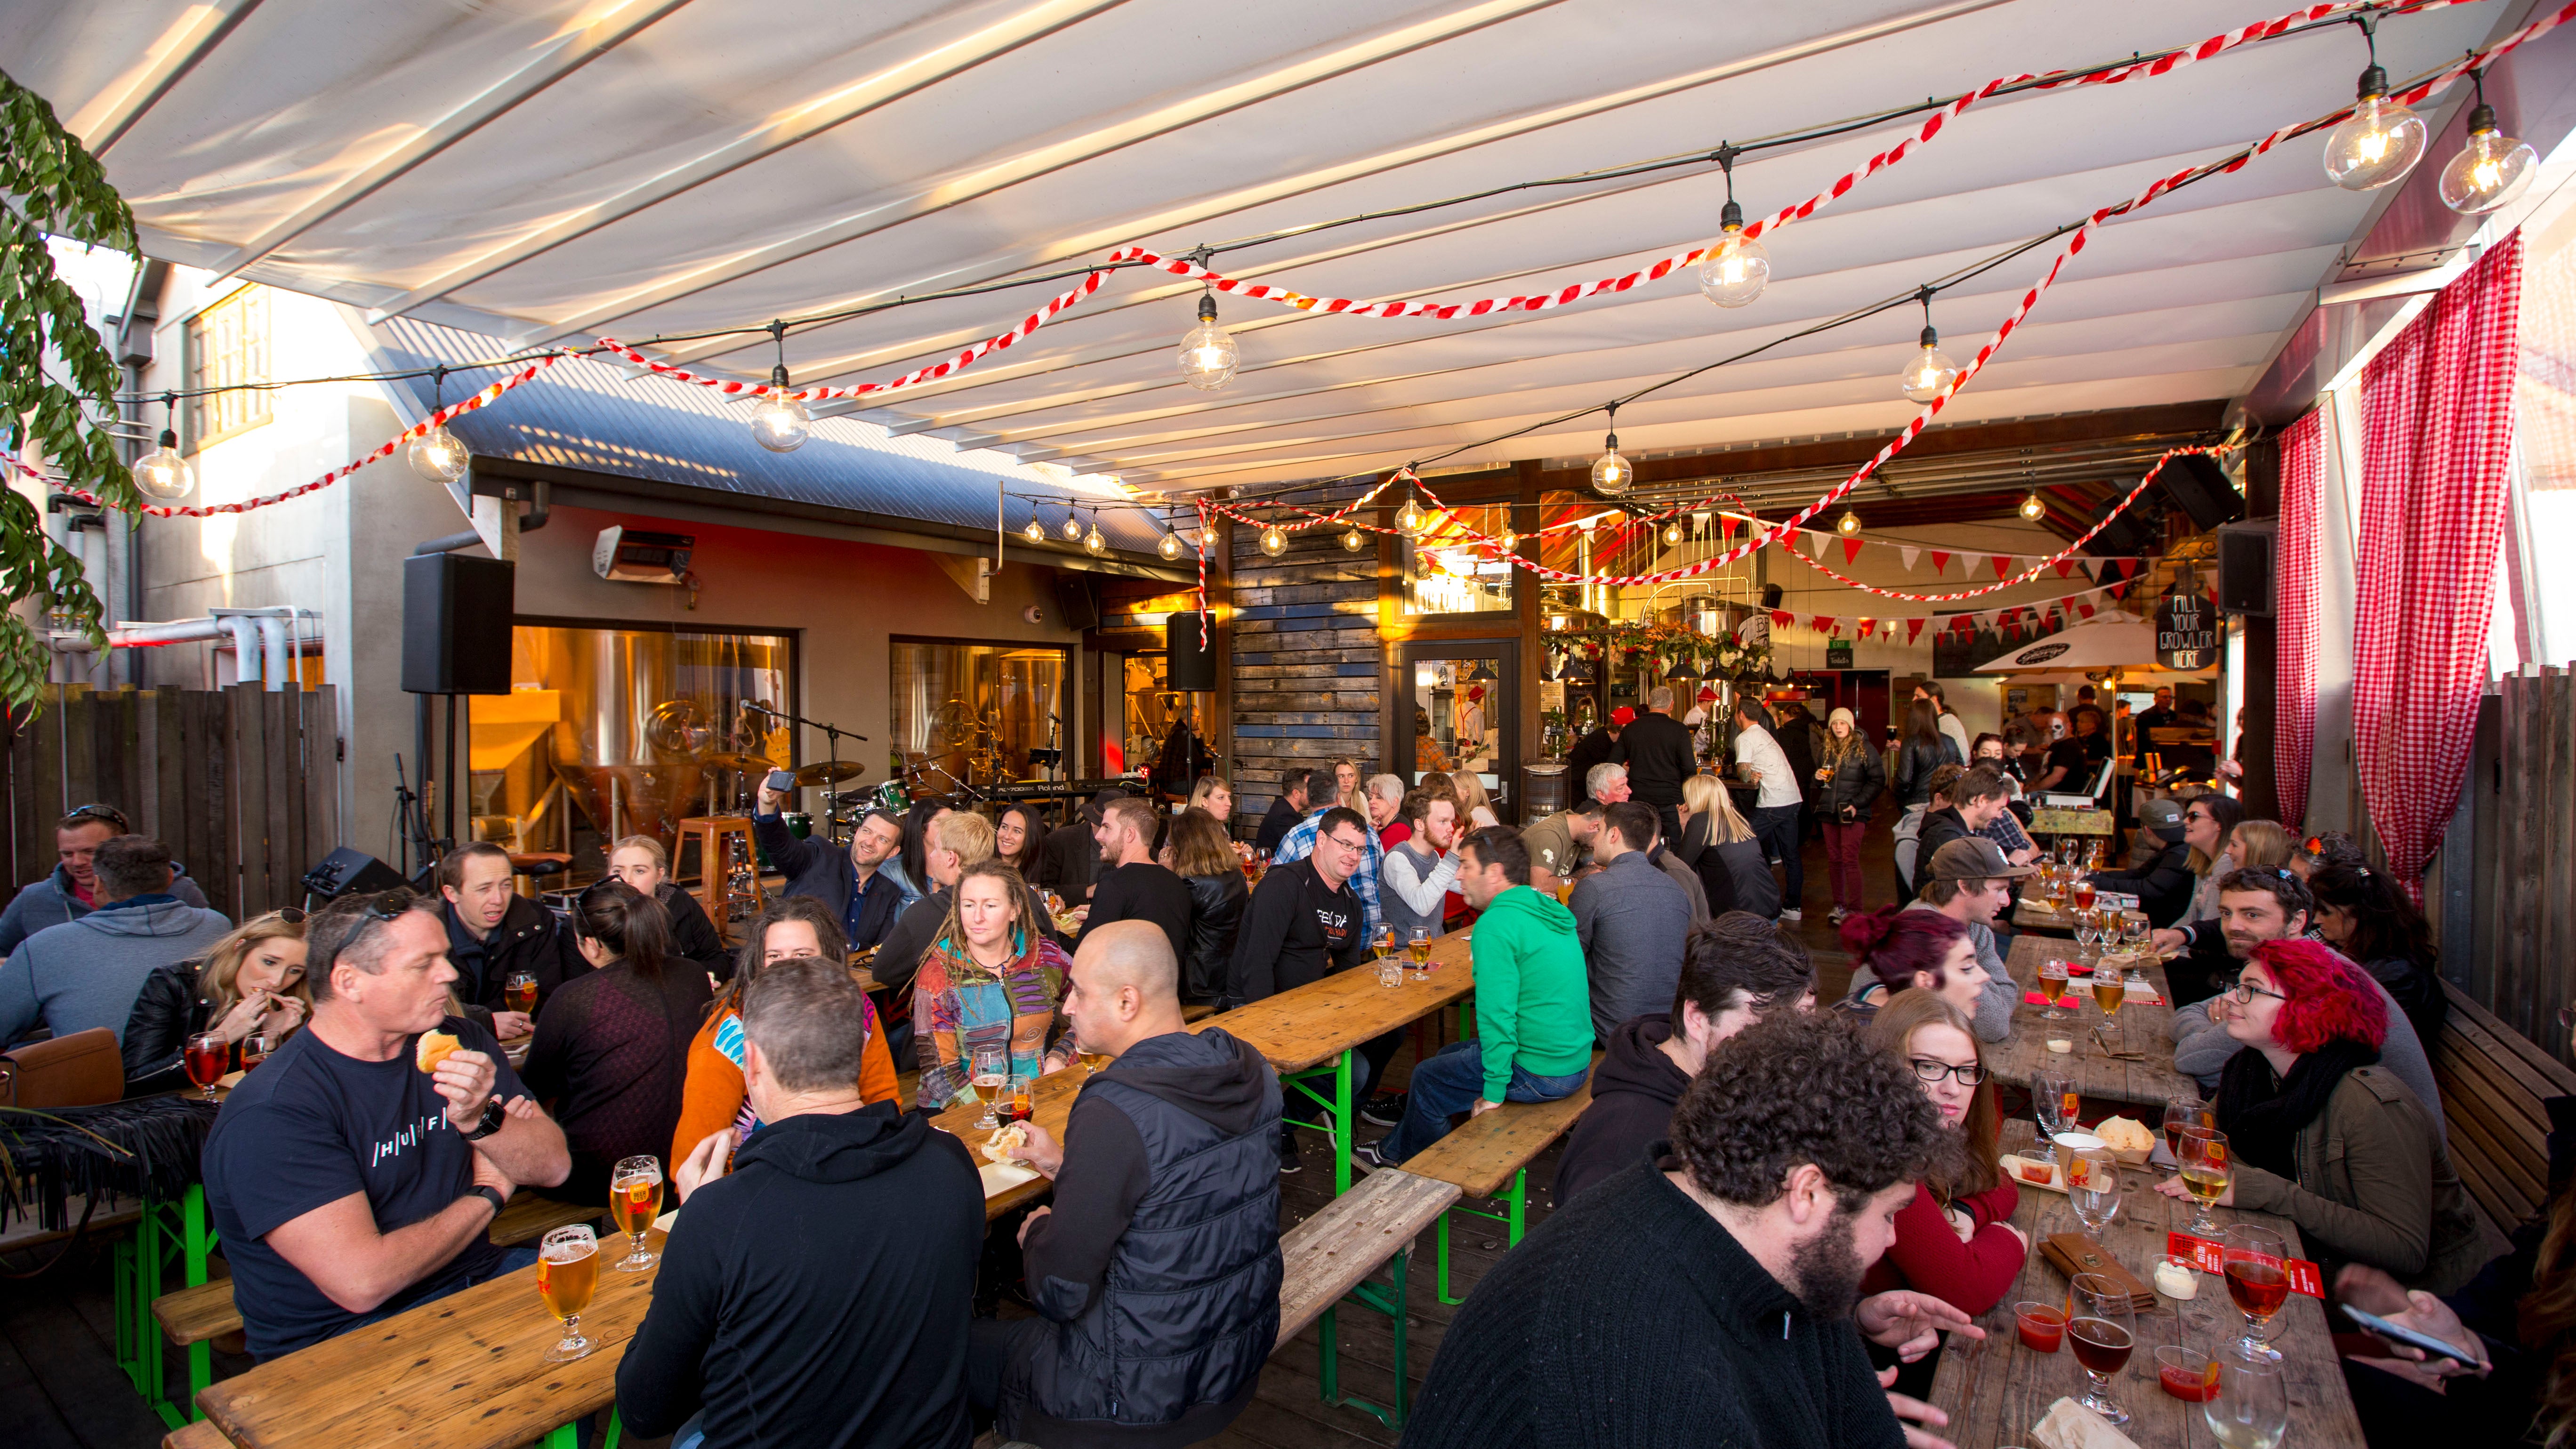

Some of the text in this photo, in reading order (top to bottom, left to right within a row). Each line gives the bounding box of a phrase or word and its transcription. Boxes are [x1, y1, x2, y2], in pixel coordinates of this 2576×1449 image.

[2174, 595, 2201, 612] FILL
[2171, 613, 2200, 631] YOUR
[2160, 631, 2213, 649] GROWLER
[2173, 650, 2200, 668] HERE
